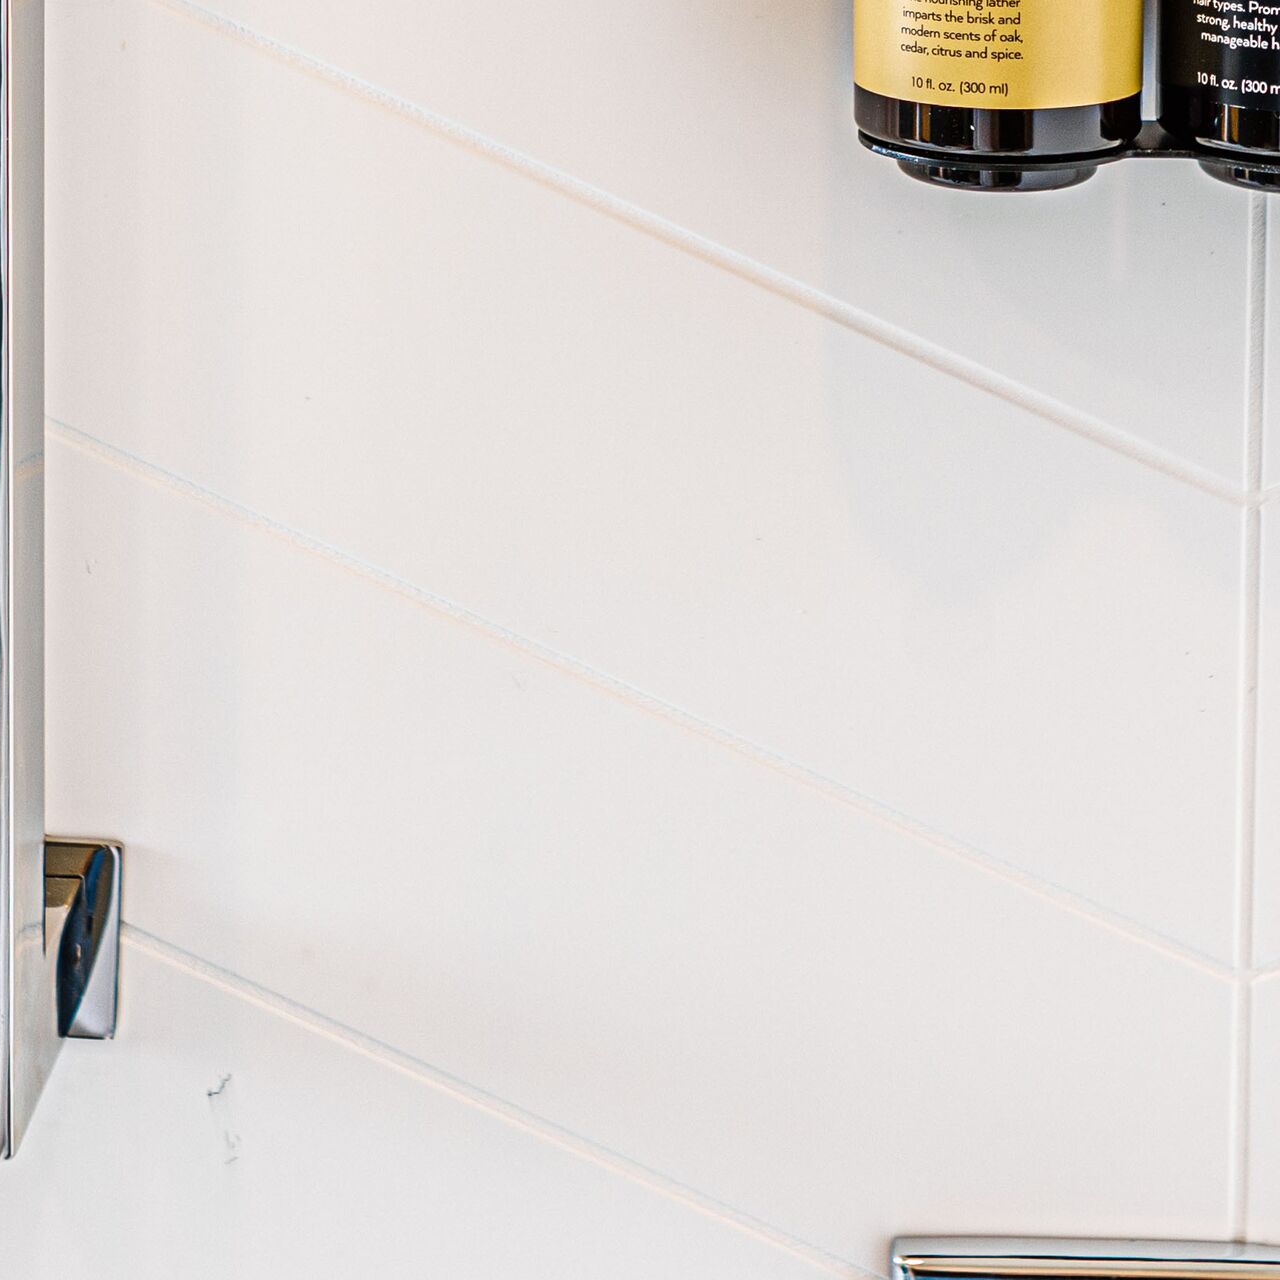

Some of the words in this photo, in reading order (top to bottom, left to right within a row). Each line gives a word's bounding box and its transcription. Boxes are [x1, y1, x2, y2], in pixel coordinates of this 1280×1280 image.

[1213, 0, 1245, 12] types.
[903, 7, 942, 22] imparts
[945, 10, 964, 23] the
[967, 11, 995, 24] brisk
[998, 13, 1021, 25] and
[901, 26, 940, 39] modern
[943, 29, 980, 41] scents
[984, 29, 997, 42] of
[1000, 30, 1023, 43] oak,
[1233, 16, 1278, 35] healthy
[1201, 30, 1268, 48] manageable
[901, 42, 929, 55] cedar,
[931, 45, 962, 58] citrus
[965, 46, 987, 59] and
[990, 48, 1024, 62] spice.
[911, 76, 923, 89] 10
[938, 82, 956, 92] oz.
[959, 80, 986, 95] (300
[989, 82, 1008, 96] ml)
[1197, 72, 1208, 84] 10
[1221, 79, 1238, 91] oz.
[1241, 78, 1268, 95] (300
